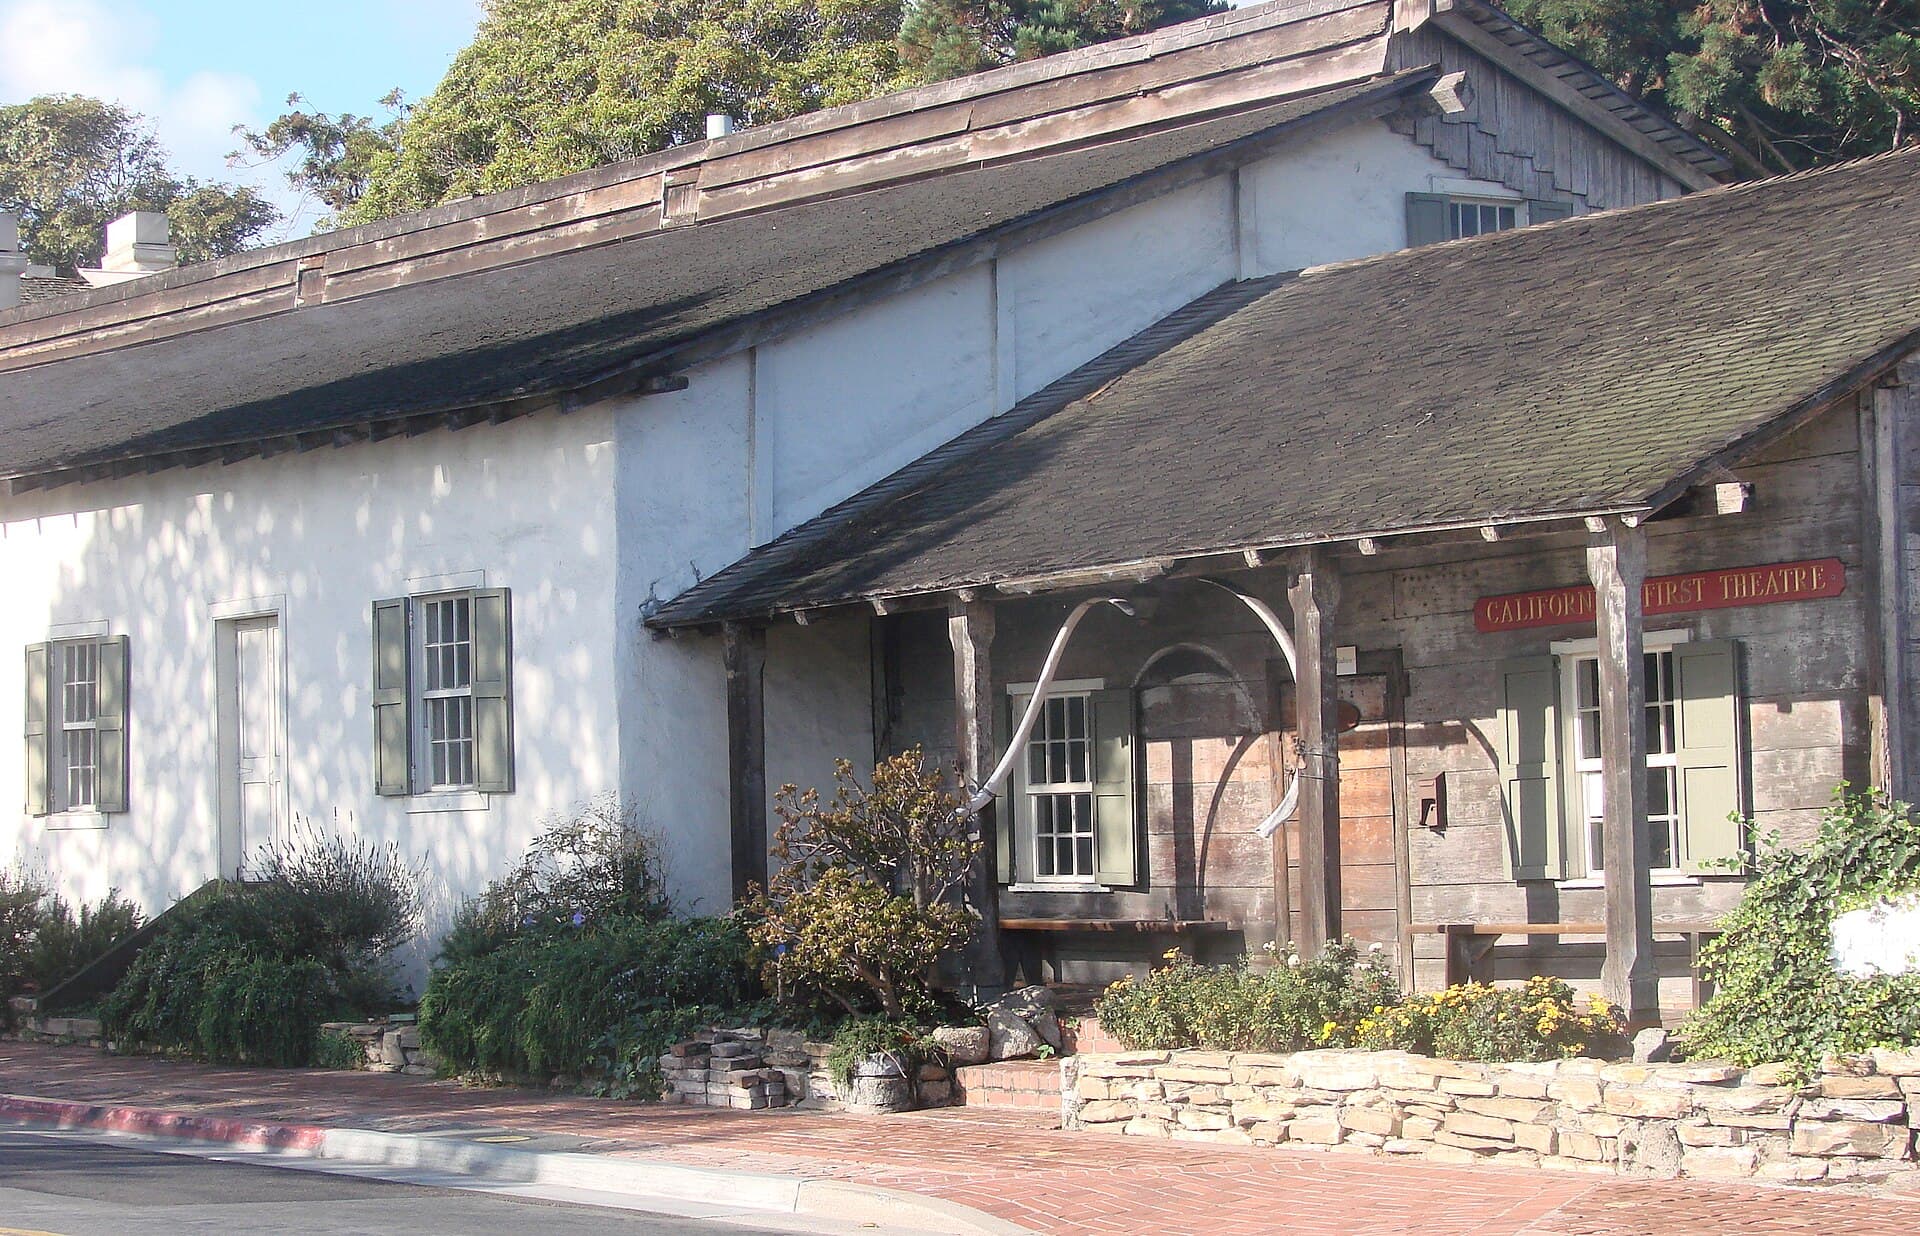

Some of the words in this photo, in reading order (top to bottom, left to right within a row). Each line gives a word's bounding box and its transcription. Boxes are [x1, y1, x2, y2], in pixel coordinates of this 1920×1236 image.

[1486, 590, 1593, 624] CALIFORN
[1643, 577, 1706, 608] FIRST
[1719, 565, 1826, 601] THEATRE
